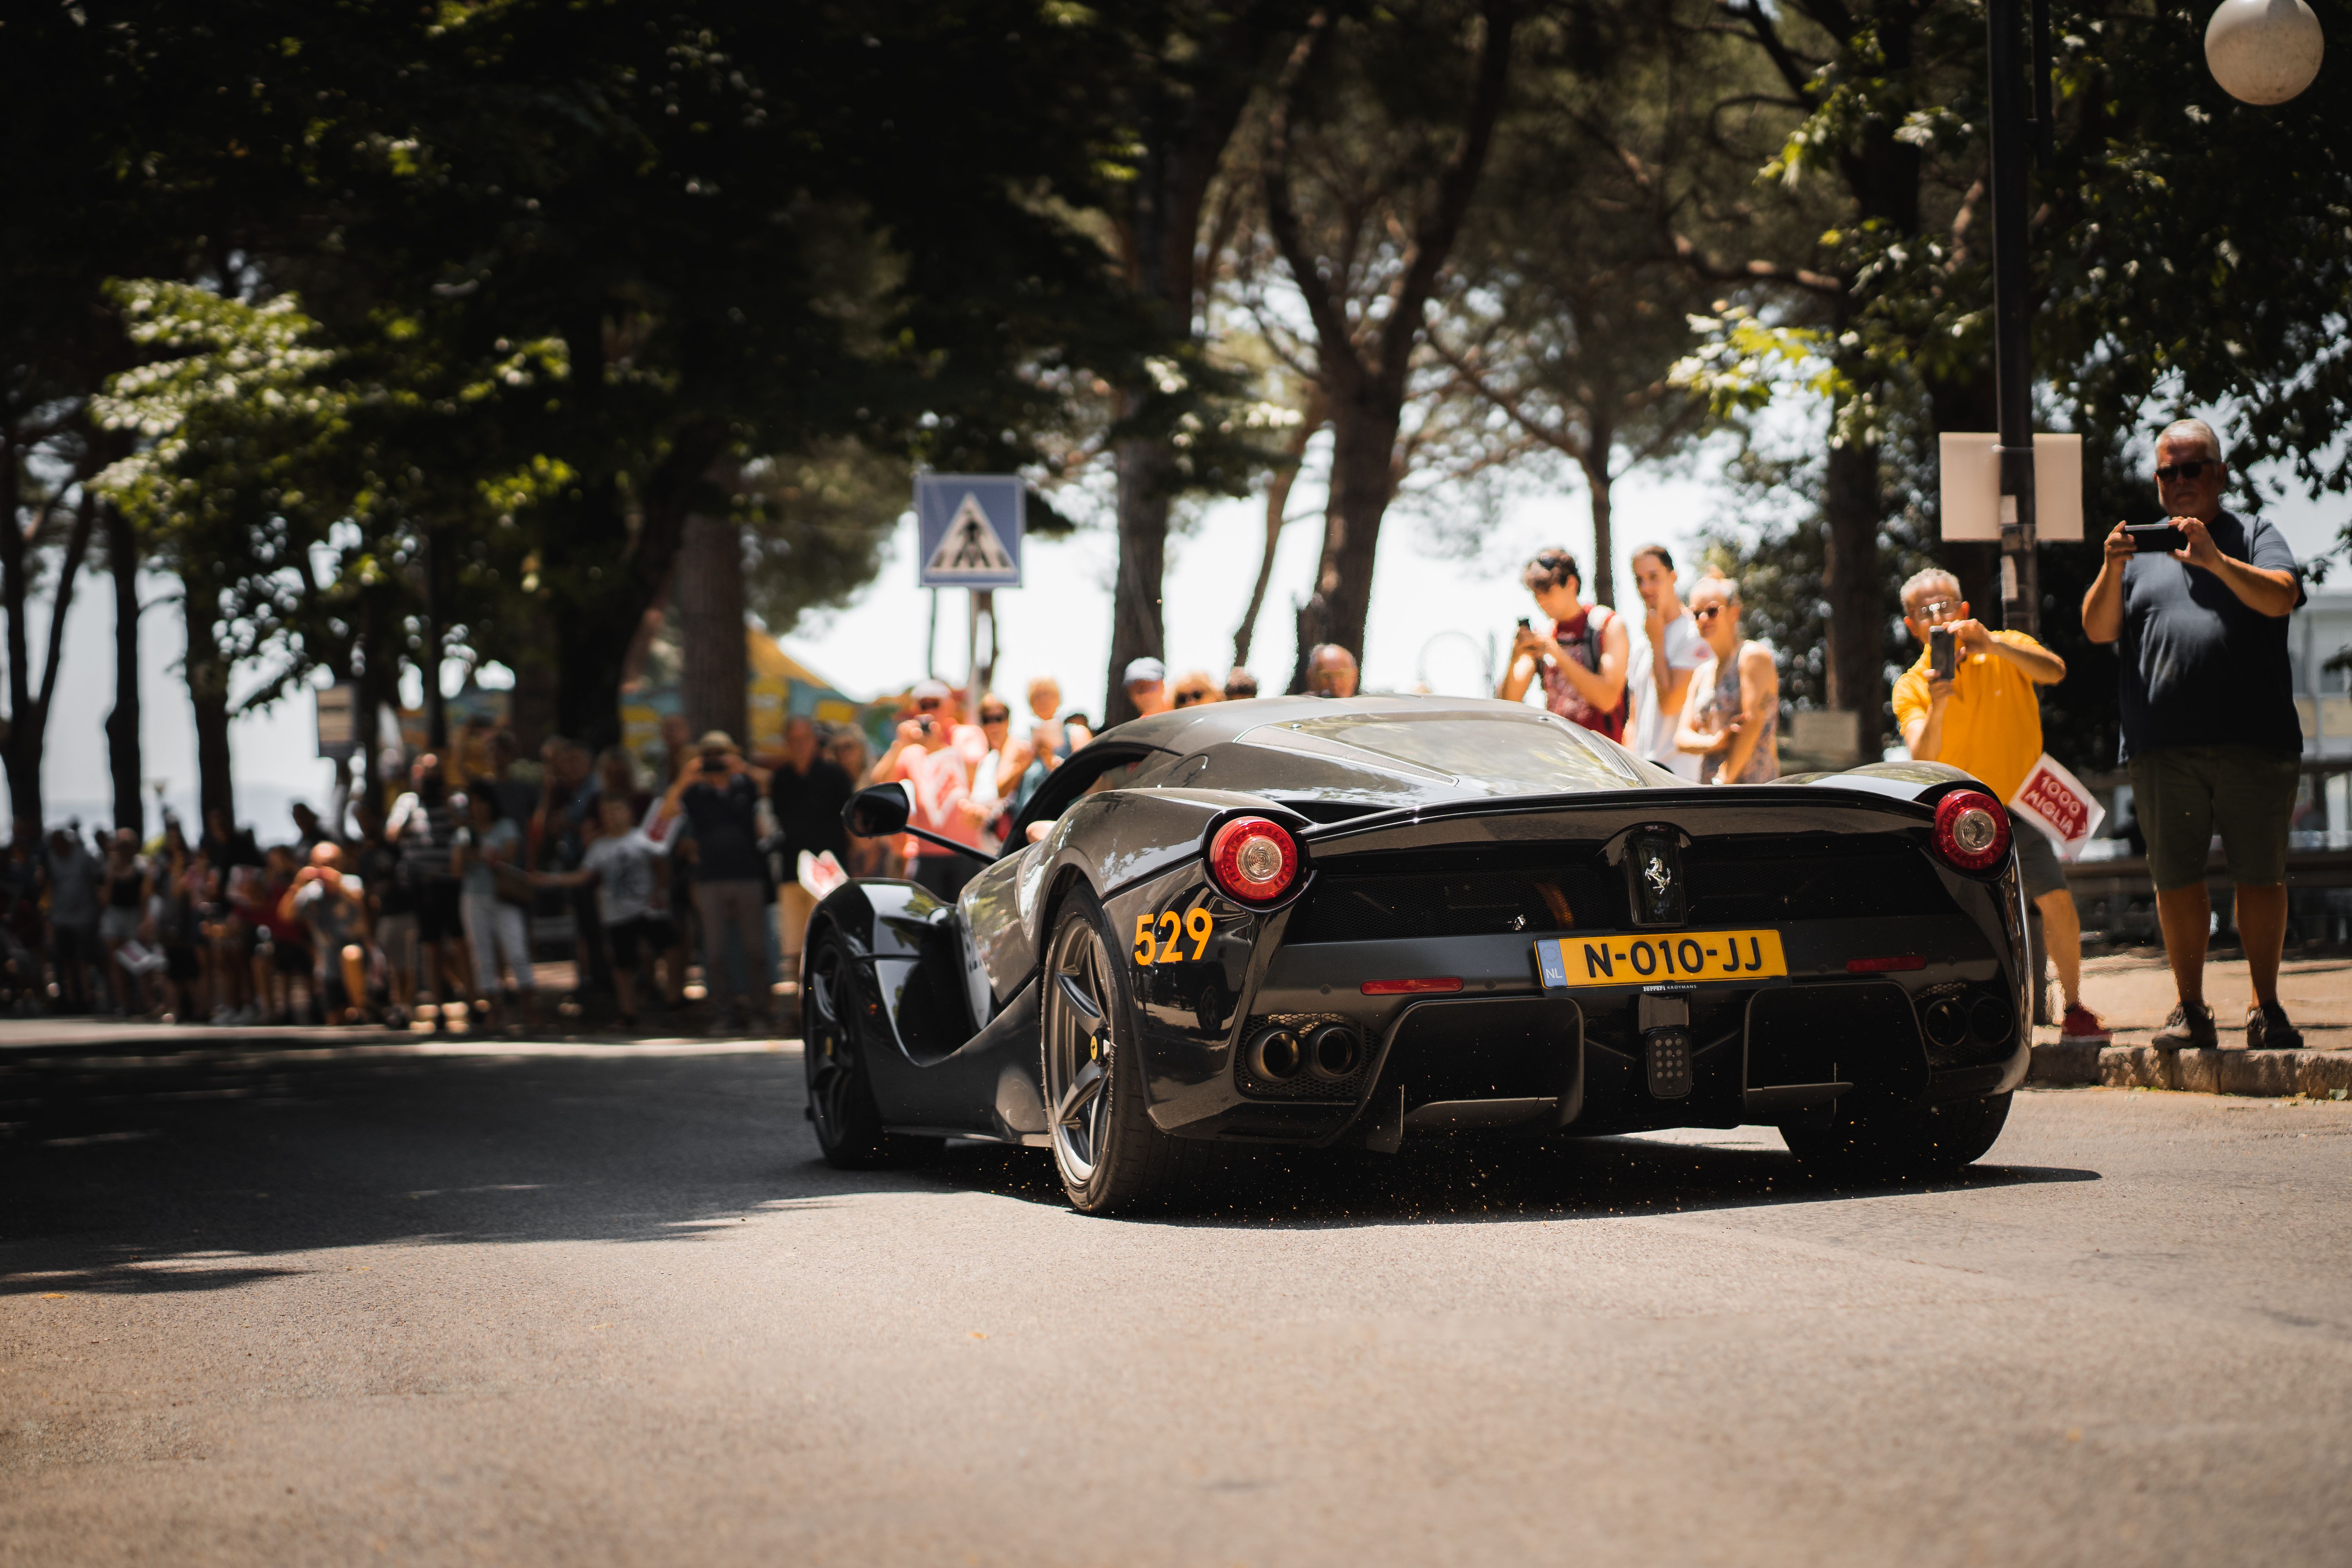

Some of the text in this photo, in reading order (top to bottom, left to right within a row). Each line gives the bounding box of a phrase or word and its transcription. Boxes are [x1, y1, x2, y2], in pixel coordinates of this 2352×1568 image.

[2024, 790, 2073, 836] MIGLIA
[2040, 776, 2080, 817] 1000
[1134, 907, 1213, 965] 529
[1584, 936, 1762, 978] N-010-JJ
[1545, 967, 1563, 979] NL
